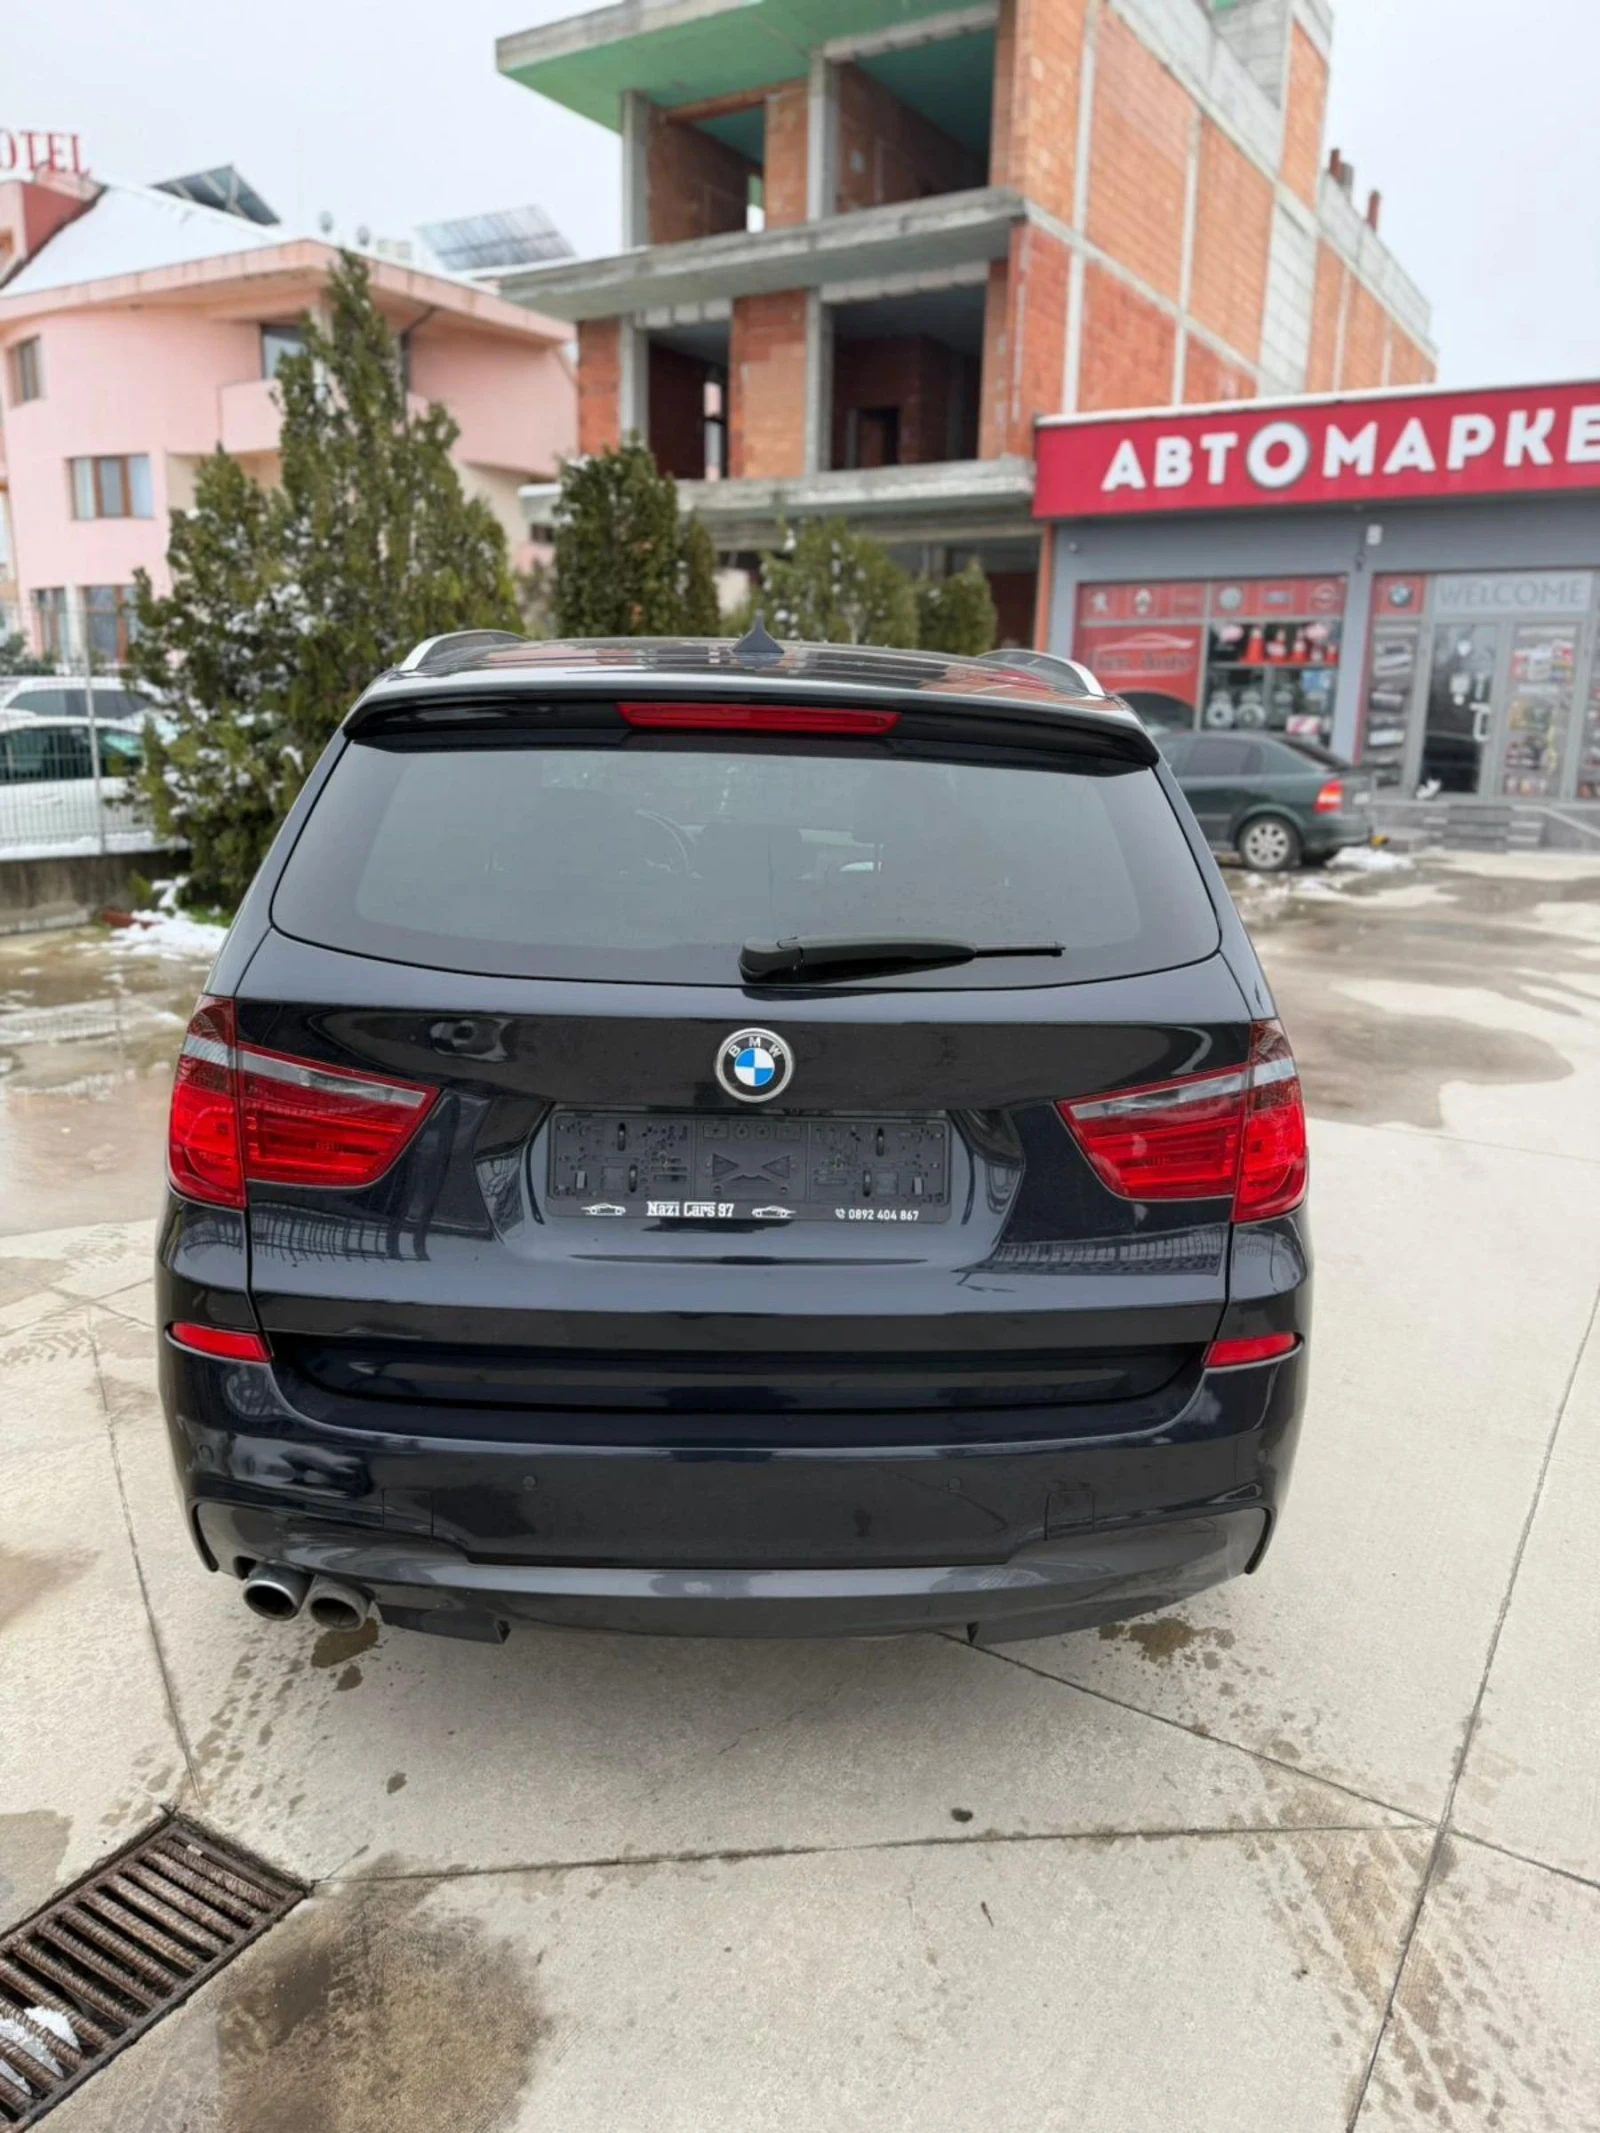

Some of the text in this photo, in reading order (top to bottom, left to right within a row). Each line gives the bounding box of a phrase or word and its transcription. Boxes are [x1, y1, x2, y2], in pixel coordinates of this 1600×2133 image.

[1101, 404, 1600, 490] АВТОМАРКЕ
[1438, 578, 1585, 608] WELCOME
[728, 1036, 782, 1058] BMW
[646, 1201, 734, 1217] Nazi Cars 97
[848, 1208, 919, 1221] 0892 404 867
